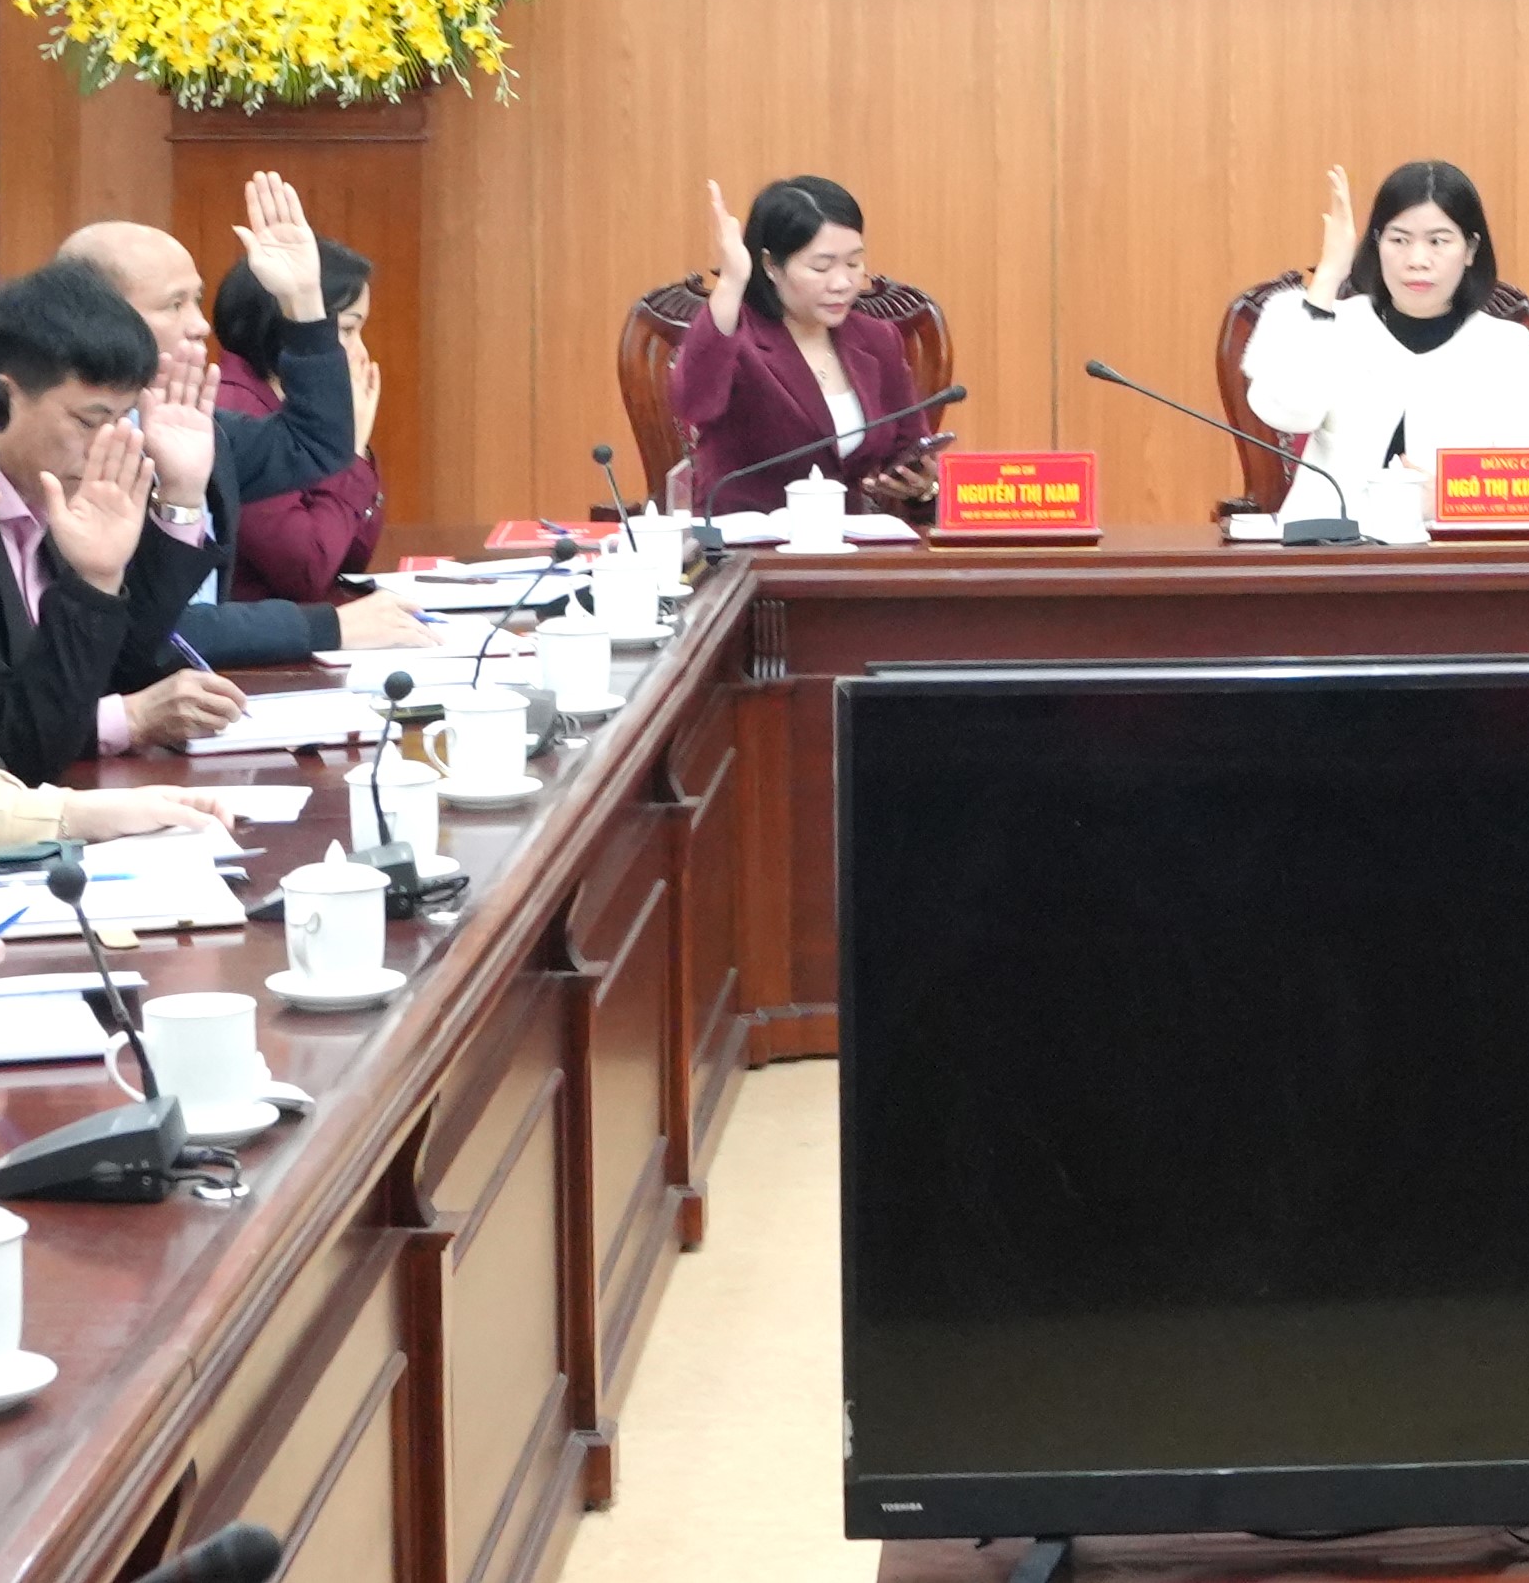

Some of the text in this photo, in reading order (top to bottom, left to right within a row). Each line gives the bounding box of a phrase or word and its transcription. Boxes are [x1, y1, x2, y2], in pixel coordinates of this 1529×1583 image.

[956, 478, 1017, 505] NGUYỄN
[1018, 483, 1043, 507] THỊ
[1446, 475, 1481, 498] NGÔ
[1483, 477, 1509, 501] THỊ
